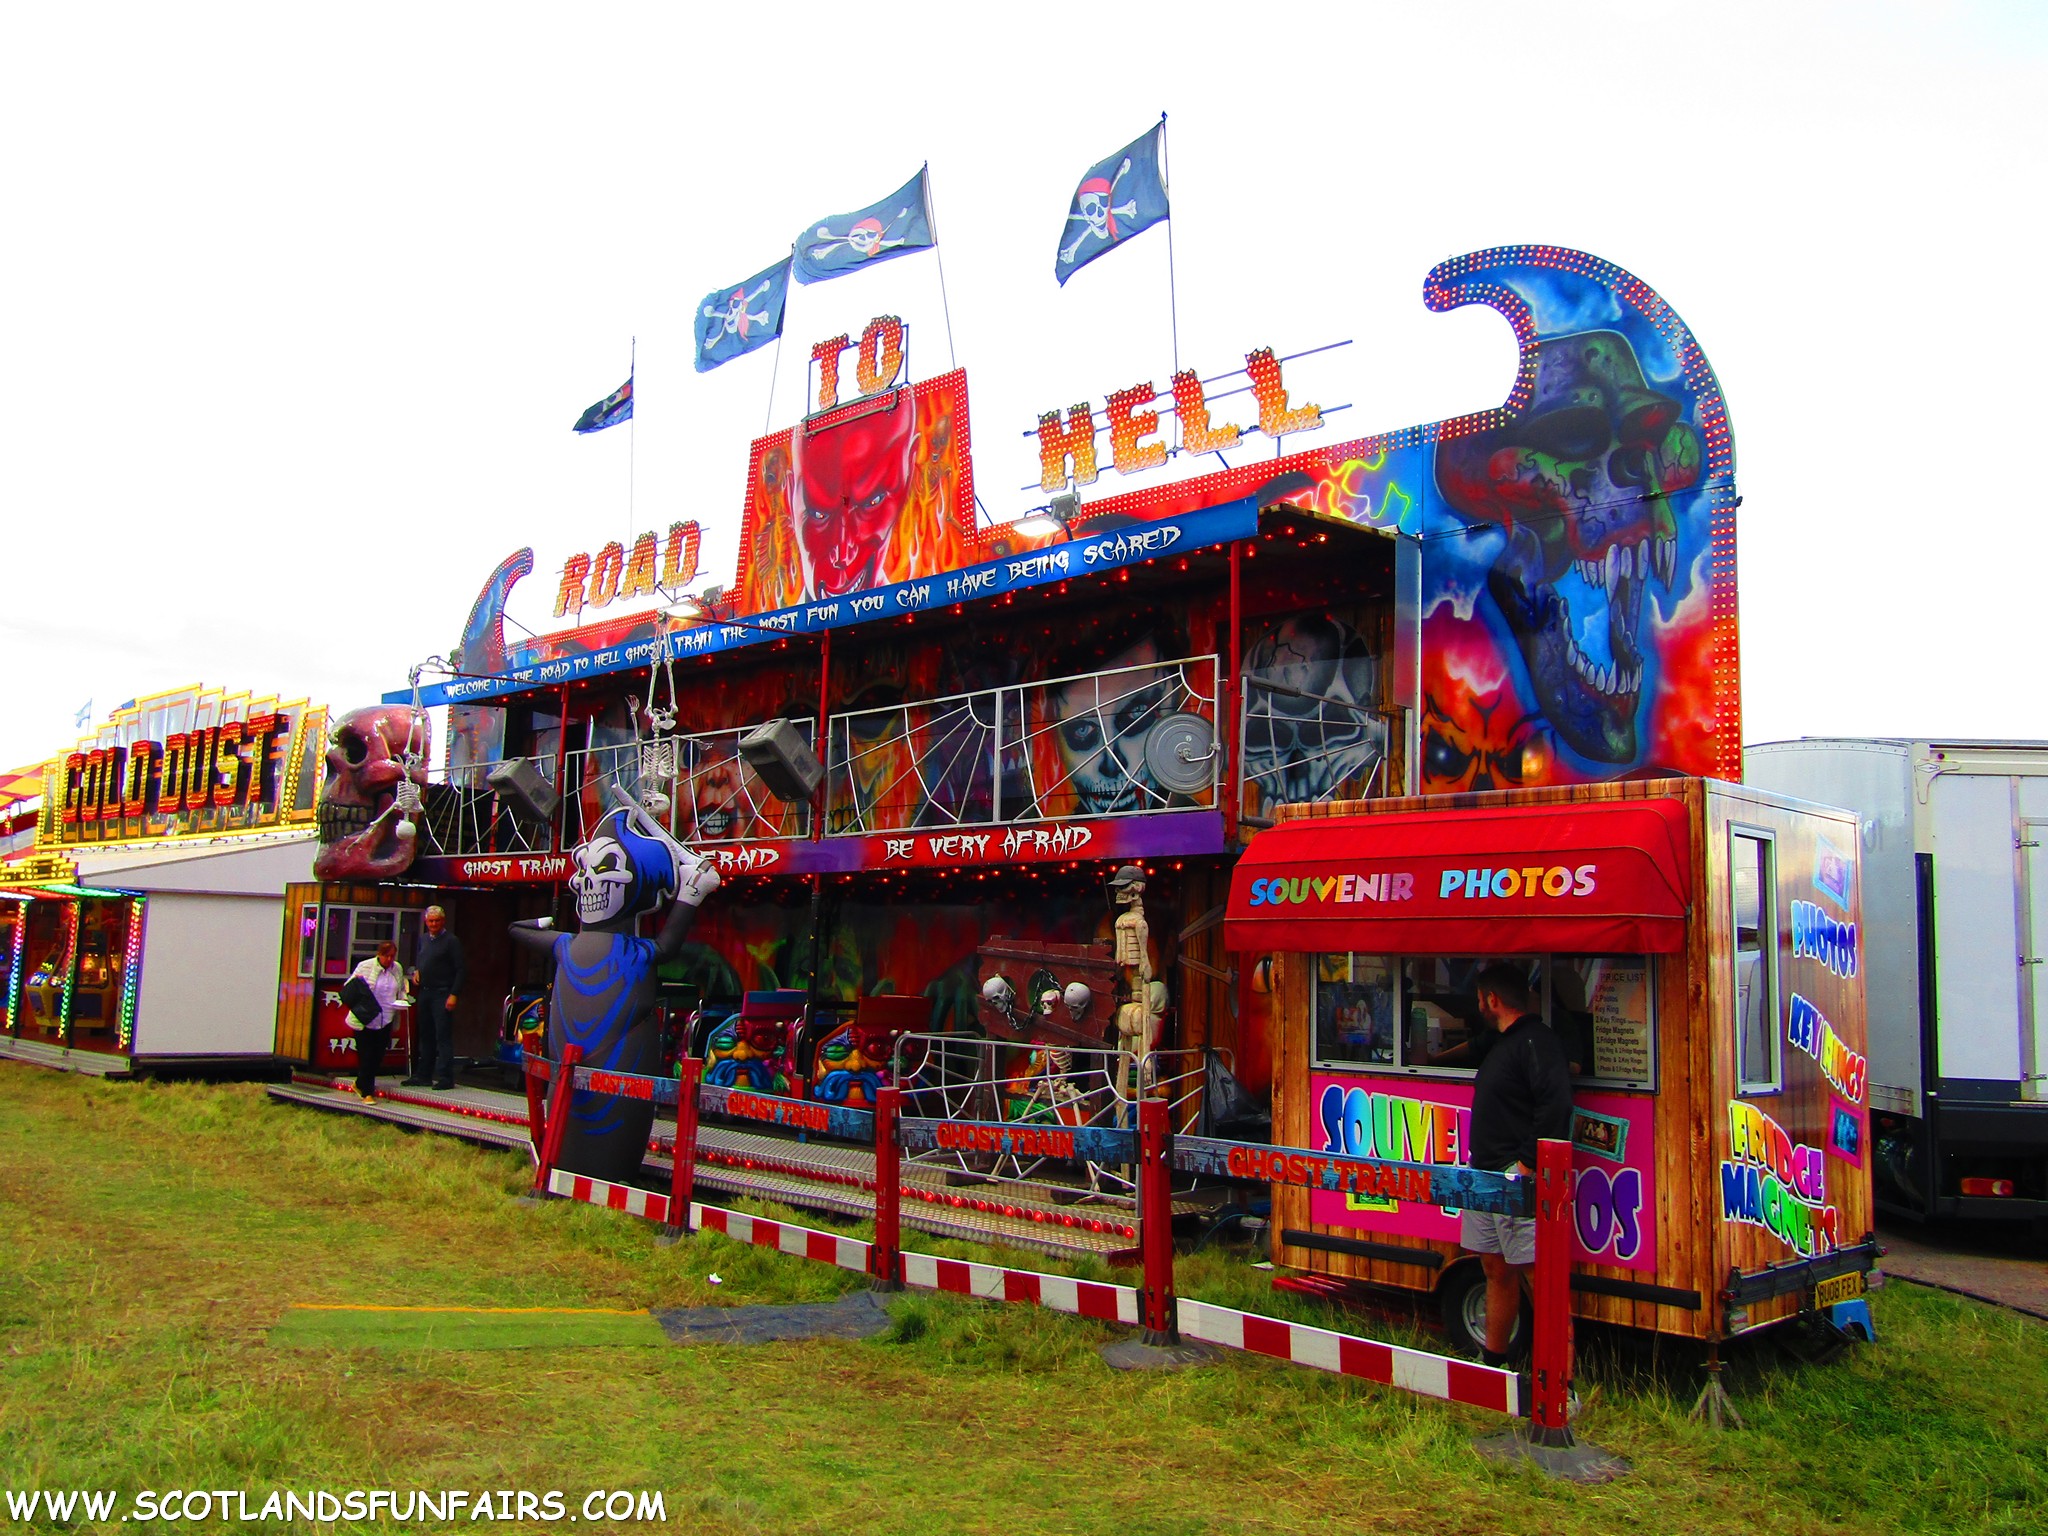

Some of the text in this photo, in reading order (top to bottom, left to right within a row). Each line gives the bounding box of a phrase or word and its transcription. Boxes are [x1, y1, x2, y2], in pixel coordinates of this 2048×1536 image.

[811, 315, 904, 411] TO
[1037, 346, 1325, 493] HELL
[553, 520, 700, 618] ROAD
[446, 679, 490, 698] WELCOME
[494, 675, 507, 690] TO
[513, 669, 533, 686] THE
[540, 661, 570, 679] ROAD
[574, 656, 588, 674] TO
[594, 650, 620, 668] HELL
[675, 629, 712, 654] TRAIN
[721, 622, 749, 645] THE
[759, 612, 798, 634] MOST
[806, 604, 839, 626] FUN
[850, 596, 885, 616] YOU
[896, 584, 930, 608] CAN
[947, 567, 997, 599] HAVE
[1006, 550, 1070, 584] BEING
[1084, 526, 1181, 564] SCARED
[63, 714, 276, 823] GOLD DUST
[463, 855, 566, 879] GHOST TRAIN
[690, 845, 780, 872] FRAID
[883, 823, 1092, 861] BE VERY AFRAID
[1249, 864, 1597, 906] SOUVENIR PHOTOS
[1600, 973, 1645, 982] PRICE LIST
[1791, 900, 1857, 979] PHOTOS
[328, 1037, 404, 1055] HL
[1788, 992, 1866, 1104] KEY RINGS
[727, 1092, 829, 1131] GHOST TRAIN
[937, 1121, 1075, 1159] GHOST TRAIN
[1320, 1084, 1472, 1166] SOUVE
[1227, 1146, 1431, 1202] GHOST TRAIN
[1729, 1100, 1824, 1204] FRIDGE
[1720, 1160, 1838, 1258] MAGNETS
